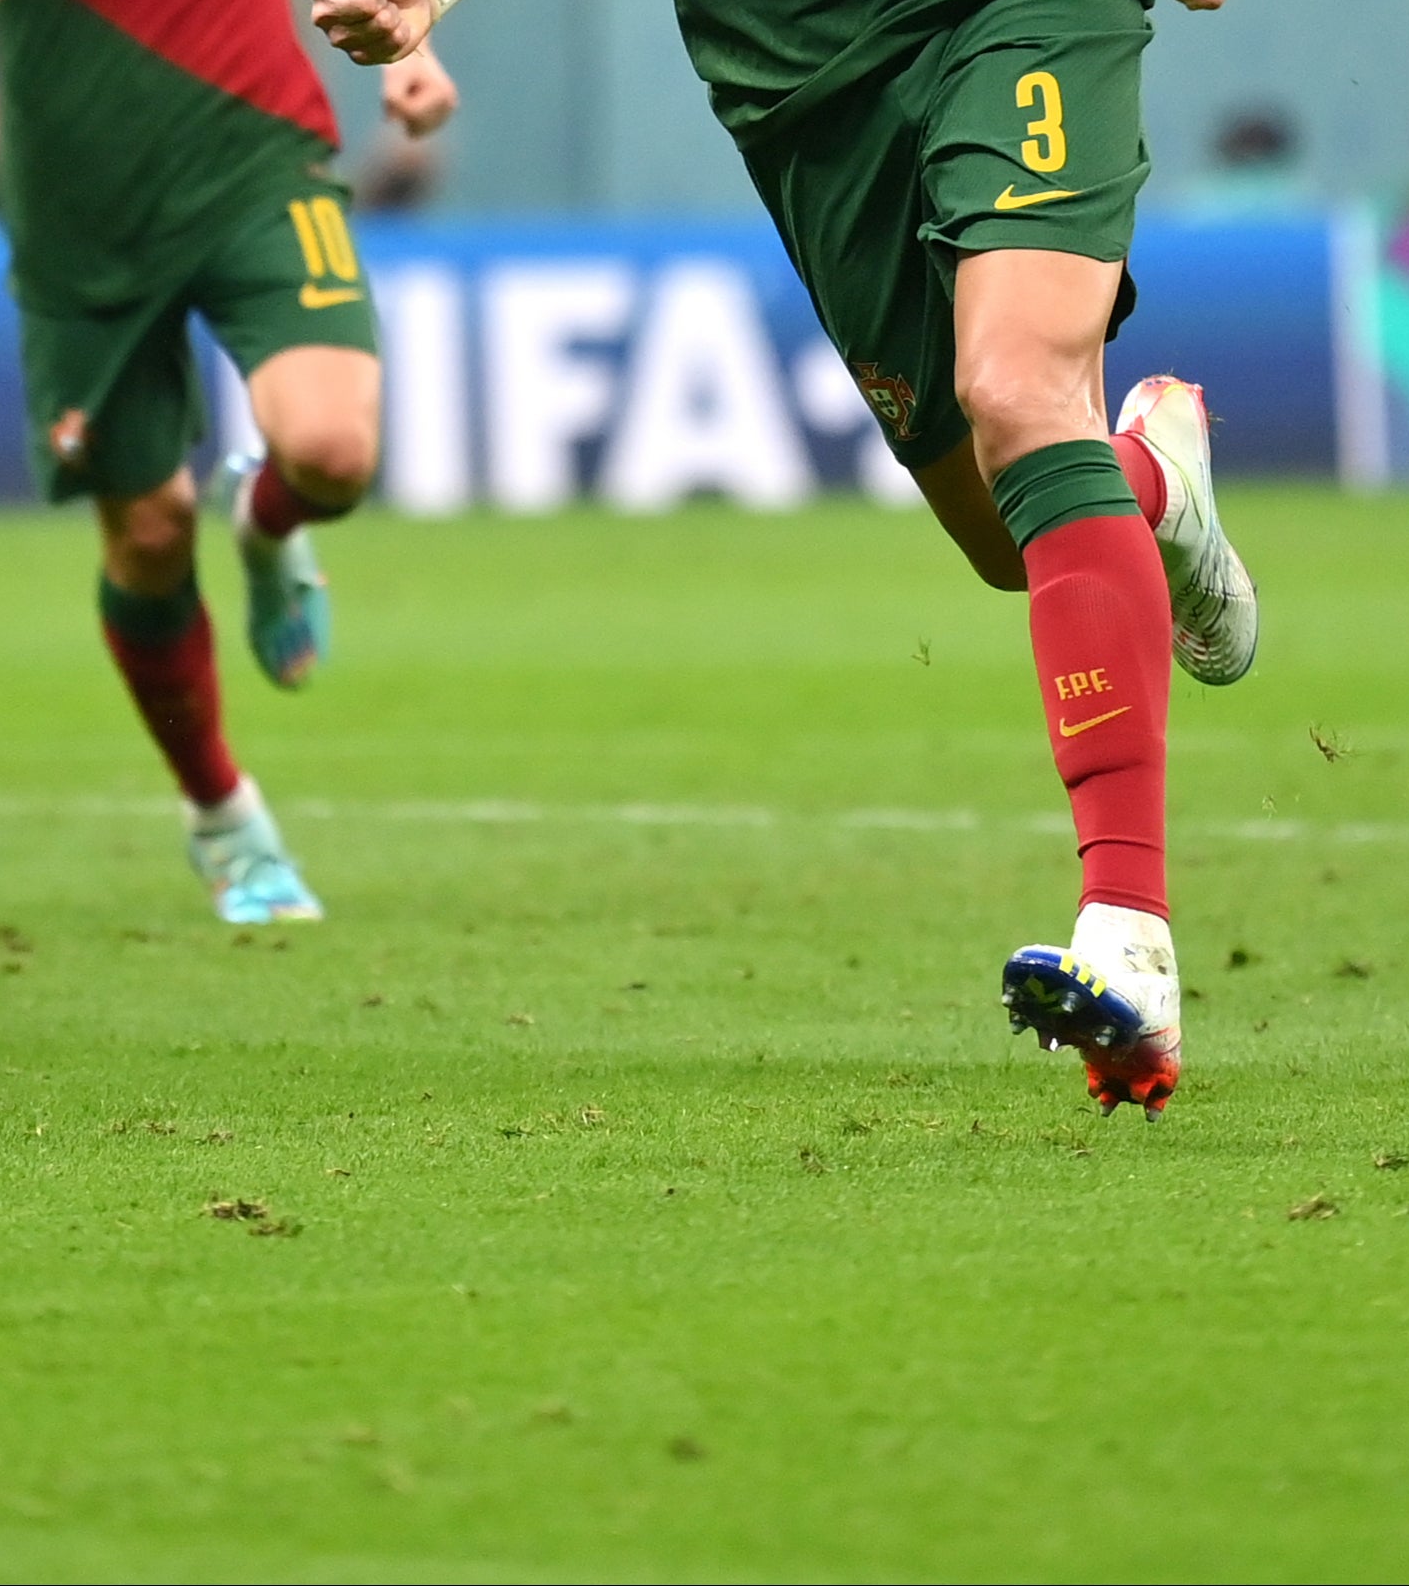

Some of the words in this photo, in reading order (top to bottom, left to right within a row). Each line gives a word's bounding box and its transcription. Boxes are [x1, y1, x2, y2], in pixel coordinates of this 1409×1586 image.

[1015, 71, 1067, 173] 3
[289, 196, 358, 282] 10
[212, 250, 812, 516] IFA
[1054, 667, 1114, 701] F.P.F.
